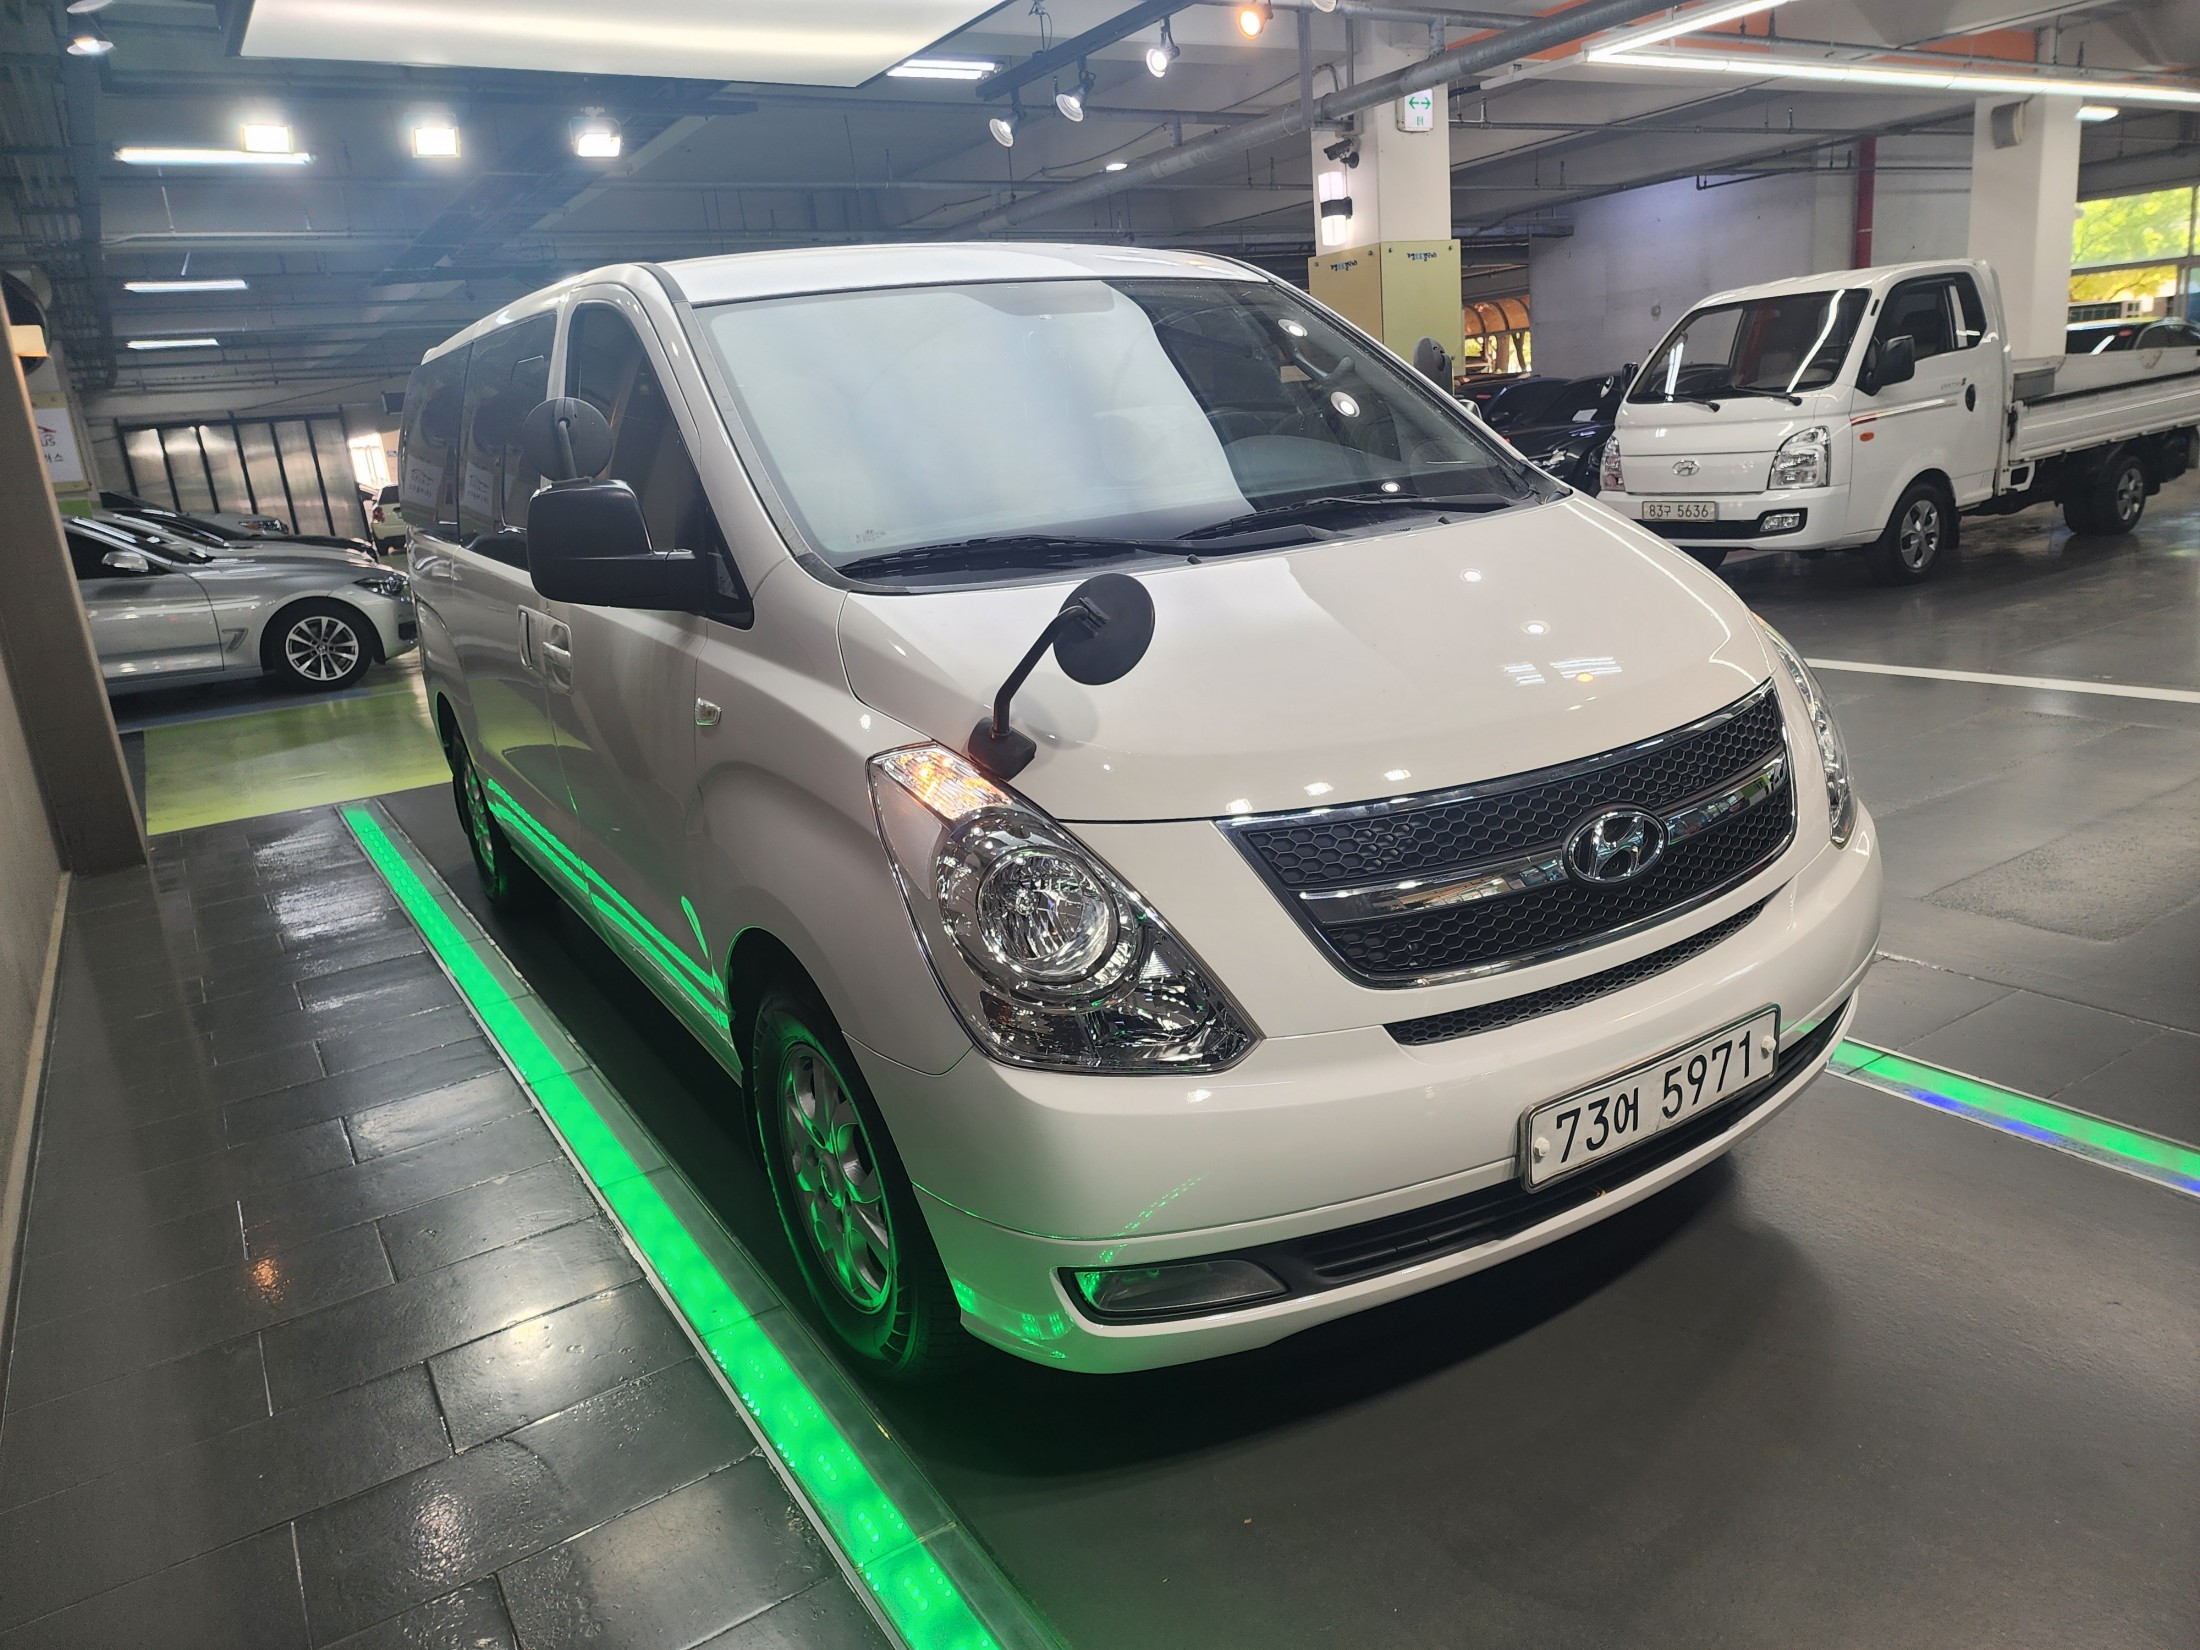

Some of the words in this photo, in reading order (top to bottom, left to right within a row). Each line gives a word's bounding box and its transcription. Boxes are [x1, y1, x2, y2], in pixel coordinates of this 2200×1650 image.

[1649, 504, 1671, 517] 83구
[1677, 504, 1709, 518] 5636
[1556, 1087, 1639, 1164] 73어
[1662, 1030, 1751, 1119] 5971
